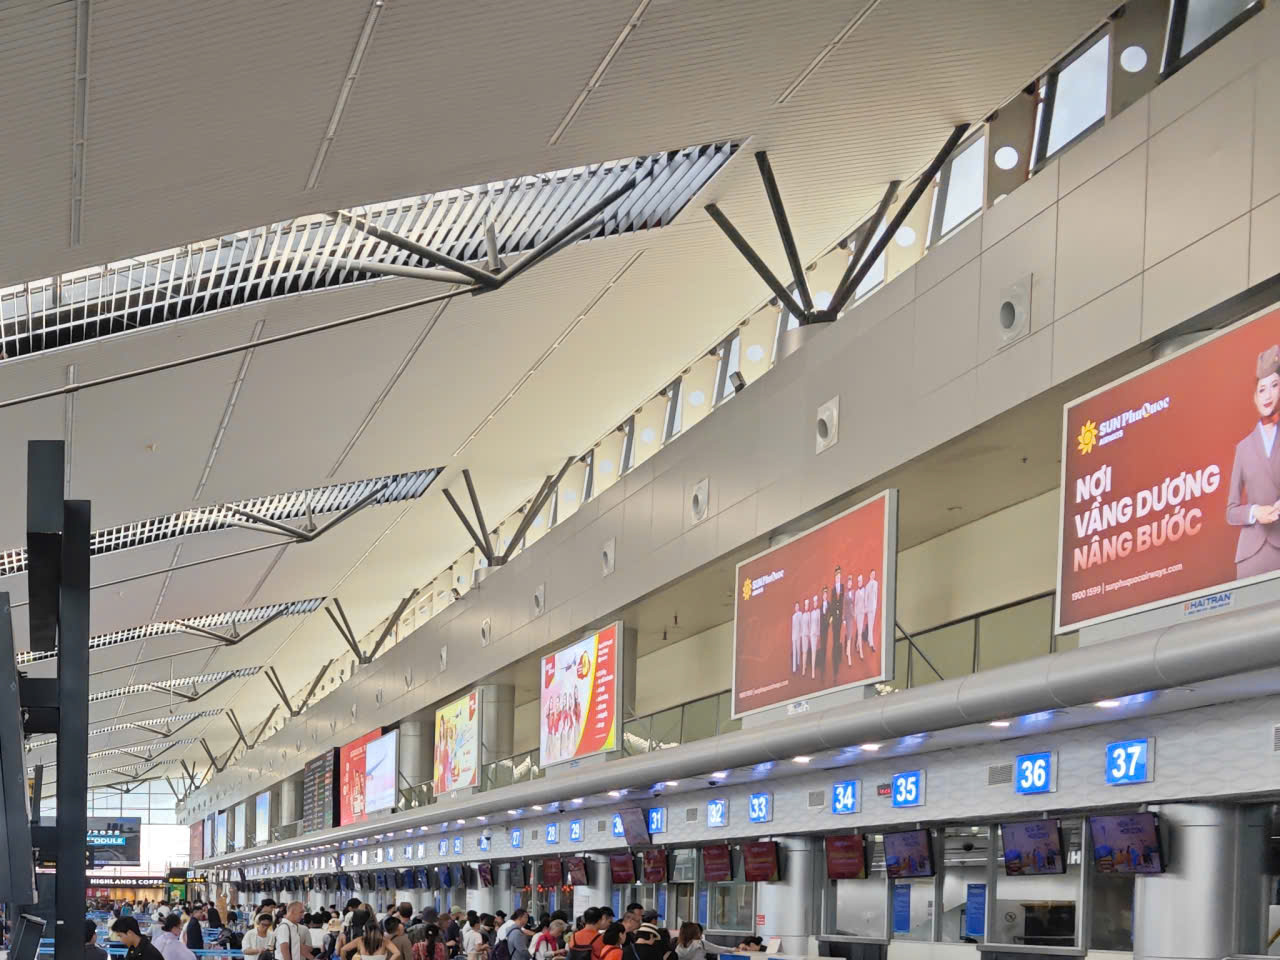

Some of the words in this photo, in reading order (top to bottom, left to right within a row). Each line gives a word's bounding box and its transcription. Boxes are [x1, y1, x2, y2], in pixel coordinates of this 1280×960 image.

[1099, 416, 1121, 436] SUN
[1075, 464, 1112, 503] NƠI
[1075, 496, 1133, 538] VẦNG
[1136, 464, 1221, 518] DƯƠNG
[1073, 531, 1133, 572] NÂNG
[1136, 505, 1202, 552] BƯỚC
[1071, 590, 1086, 601] 1900
[1112, 746, 1141, 778] 37
[1021, 760, 1046, 788] 36
[835, 787, 853, 809] 34
[896, 776, 916, 802] 35
[710, 804, 722, 823] 32
[752, 797, 766, 818] 33
[571, 823, 579, 838] 29
[652, 811, 661, 830] 31
